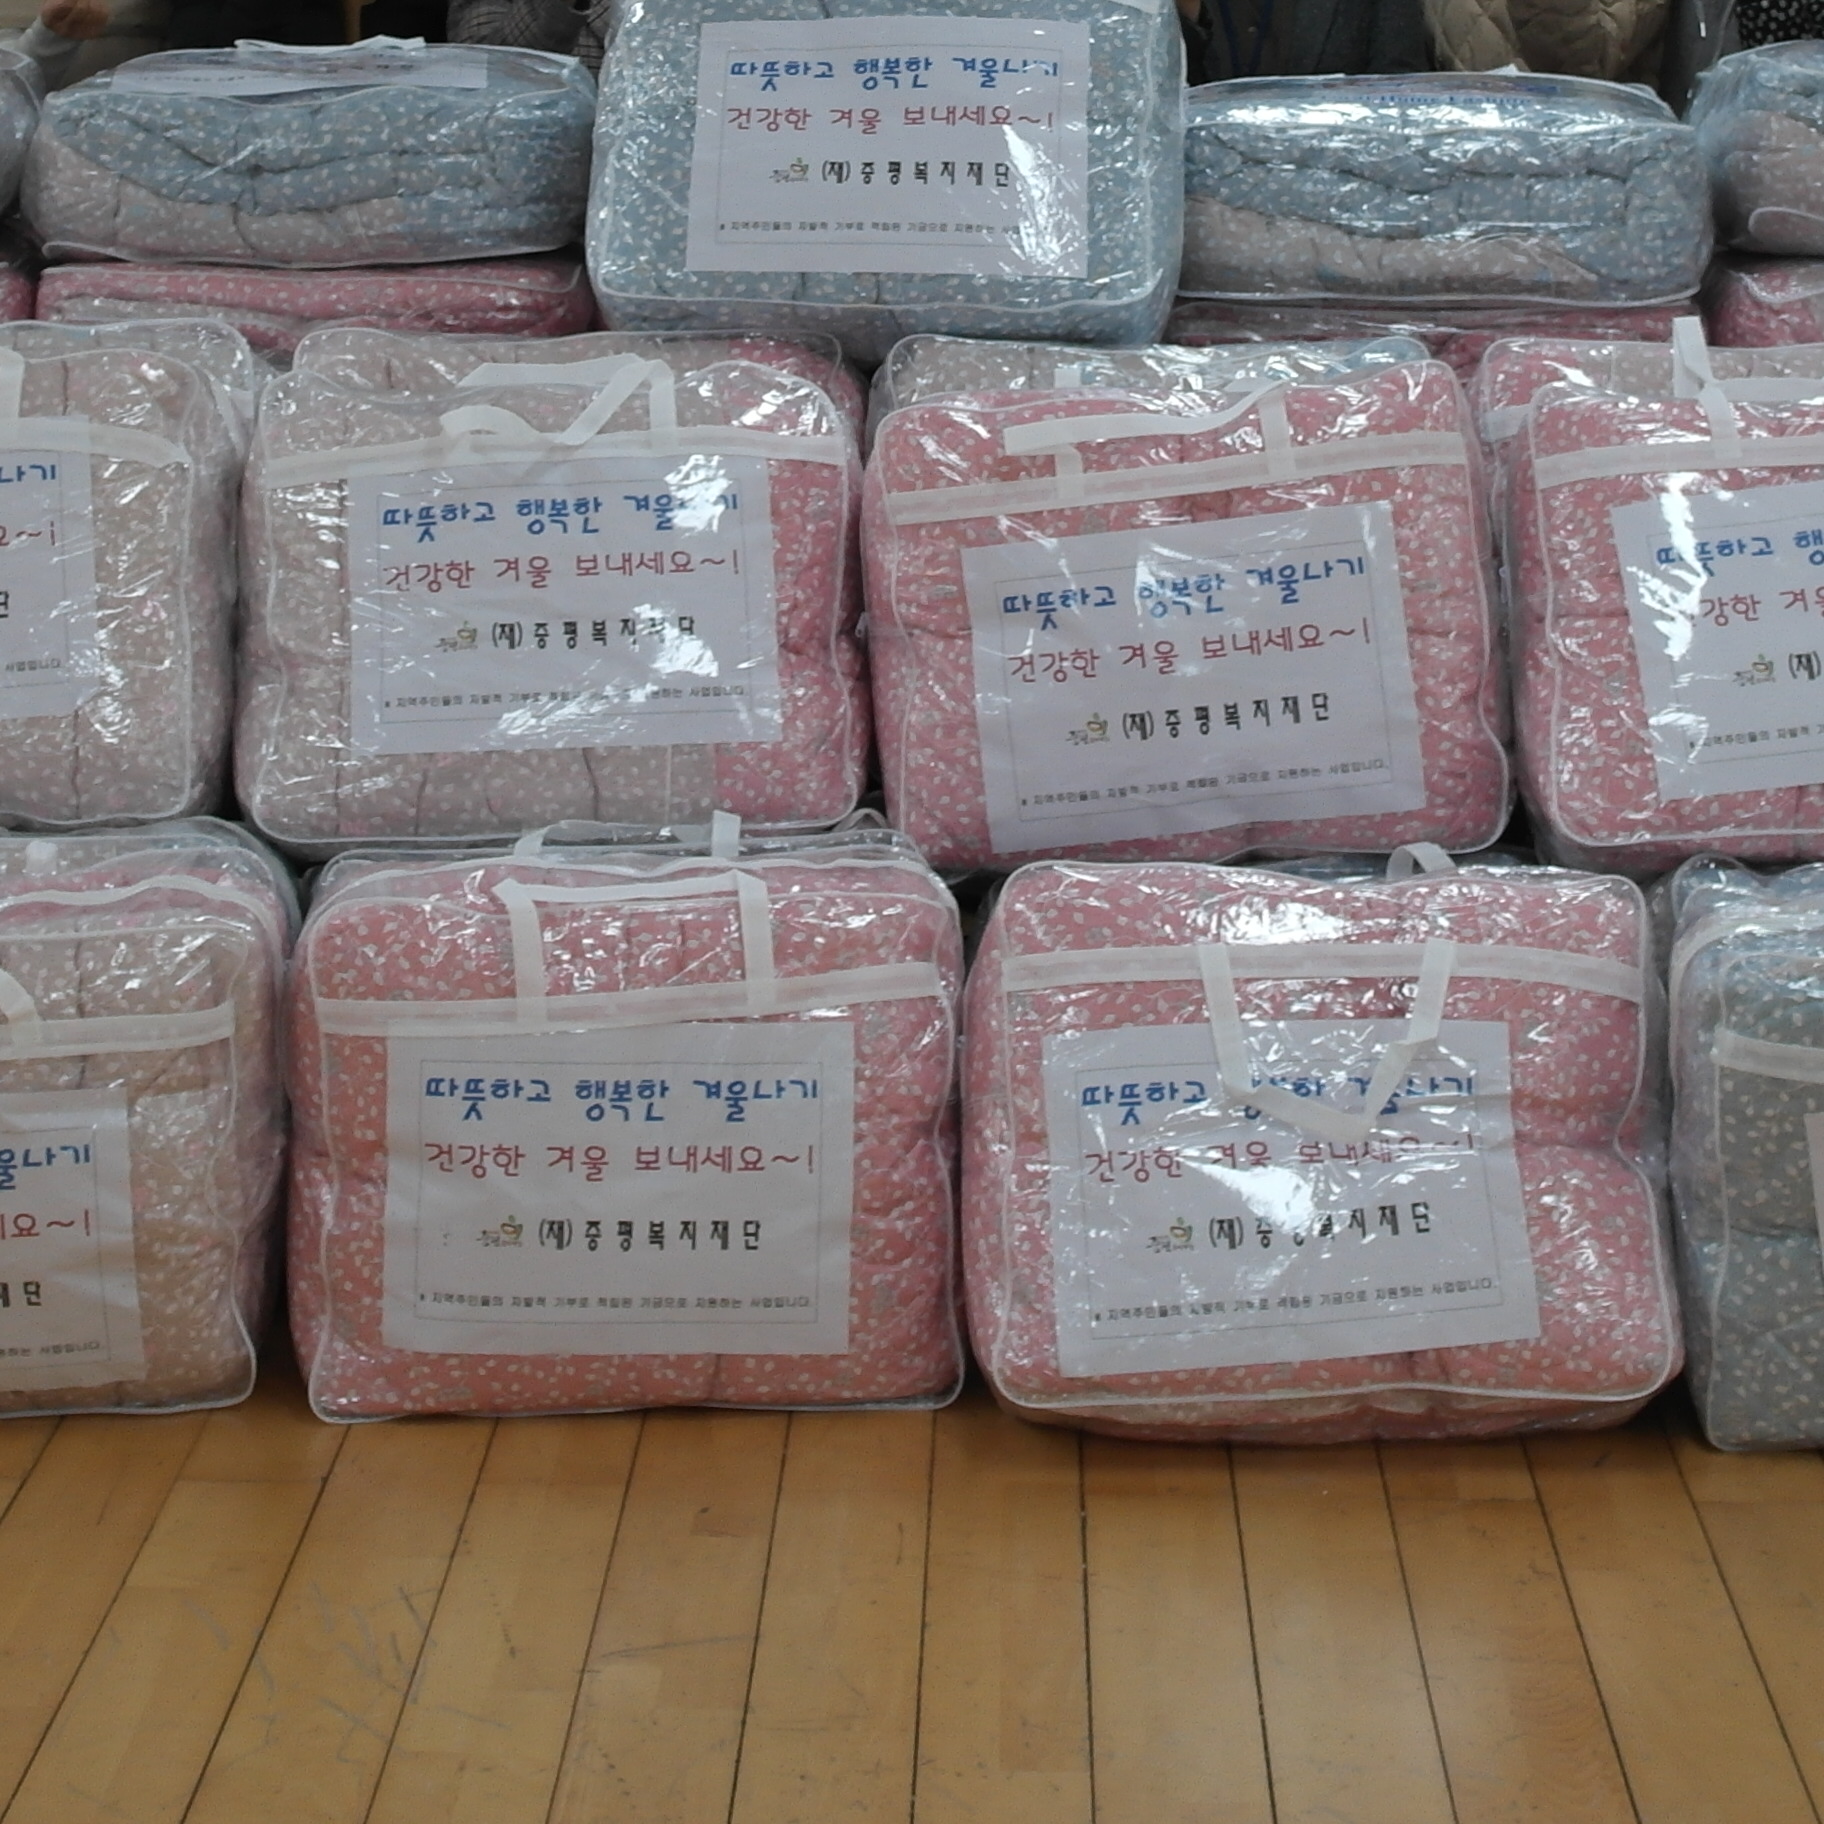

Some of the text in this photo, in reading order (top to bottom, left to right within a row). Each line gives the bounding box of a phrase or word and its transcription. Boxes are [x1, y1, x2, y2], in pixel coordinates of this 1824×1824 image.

[730, 57, 1058, 91] 따뜻하고 행복한 겨울나기
[726, 106, 1053, 134] 건강한 겨울 보내세요~!
[383, 493, 737, 543] 따뜻하고 행복한 겨울기
[383, 550, 739, 593] 건강한 겨울 보내세요~!
[1003, 557, 1364, 631] 따뜻하고 행복한 겨울나기
[1681, 593, 1762, 628] 강한
[1007, 618, 1371, 683] 건강한 겨울 보내세요~!
[425, 1078, 818, 1123] 따뜻하고 행복한 겨울나기
[1081, 1080, 1207, 1125] 따뜻하고
[424, 1143, 815, 1182] 건강한 겨울 보내세요~!
[1084, 1145, 1183, 1183] 건강한
